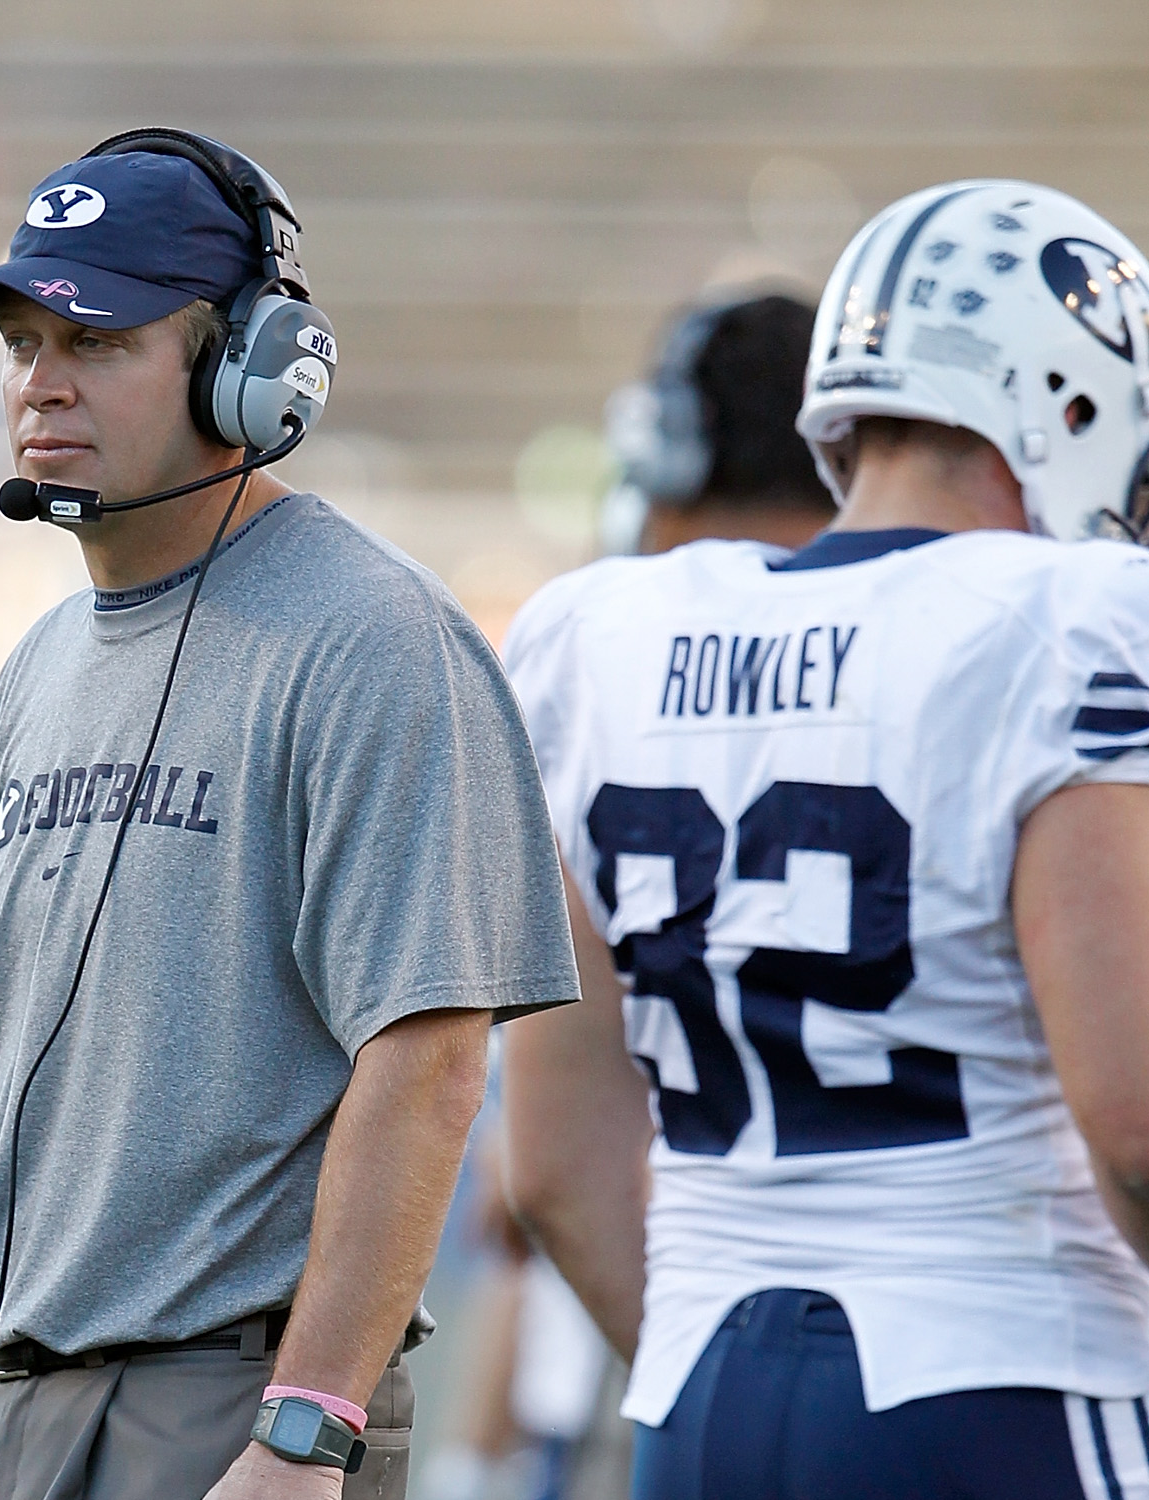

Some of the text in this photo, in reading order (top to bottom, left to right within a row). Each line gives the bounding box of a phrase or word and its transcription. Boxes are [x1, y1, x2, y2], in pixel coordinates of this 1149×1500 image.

[41, 189, 94, 223] Y
[310, 332, 332, 358] BYU
[293, 366, 318, 389] Sprint
[139, 580, 174, 600] NIKE
[179, 564, 202, 584] PR
[660, 626, 858, 718] ROWLEY
[587, 781, 970, 1157] 82
